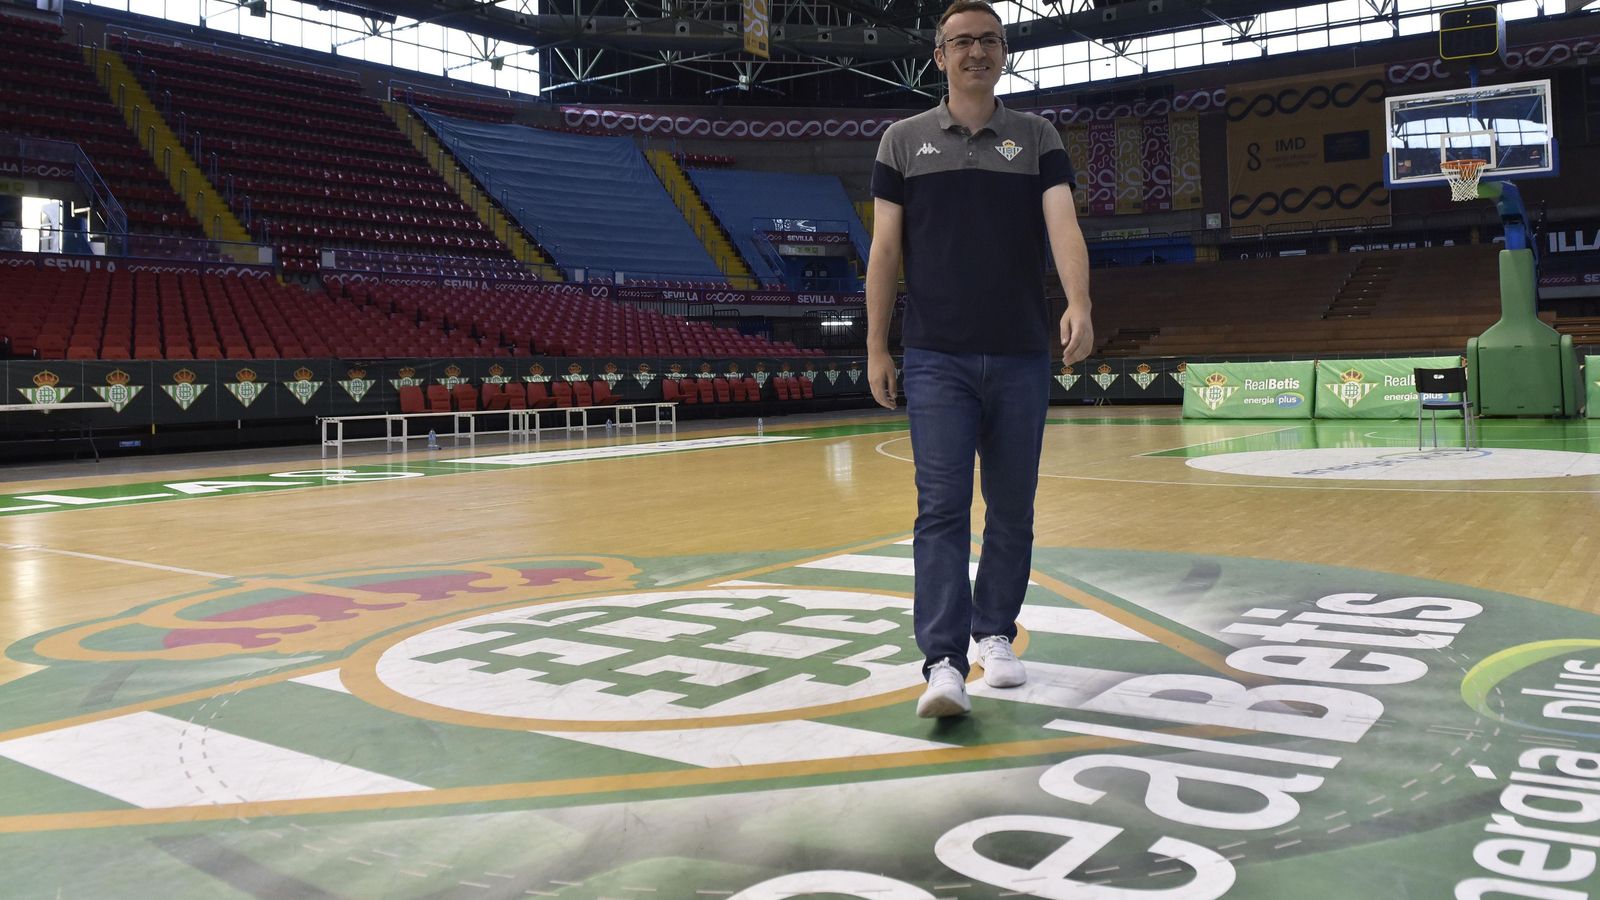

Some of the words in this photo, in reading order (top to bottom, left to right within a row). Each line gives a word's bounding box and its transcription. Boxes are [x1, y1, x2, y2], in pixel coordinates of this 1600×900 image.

[1275, 136, 1306, 152] IMD
[787, 234, 814, 242] SEVILLA
[797, 294, 836, 304] SEVILLA
[1244, 377, 1300, 391] RealBetis
[1278, 395, 1297, 405] plus
[1422, 392, 1444, 401] plus
[724, 592, 1484, 900] ealBetis
